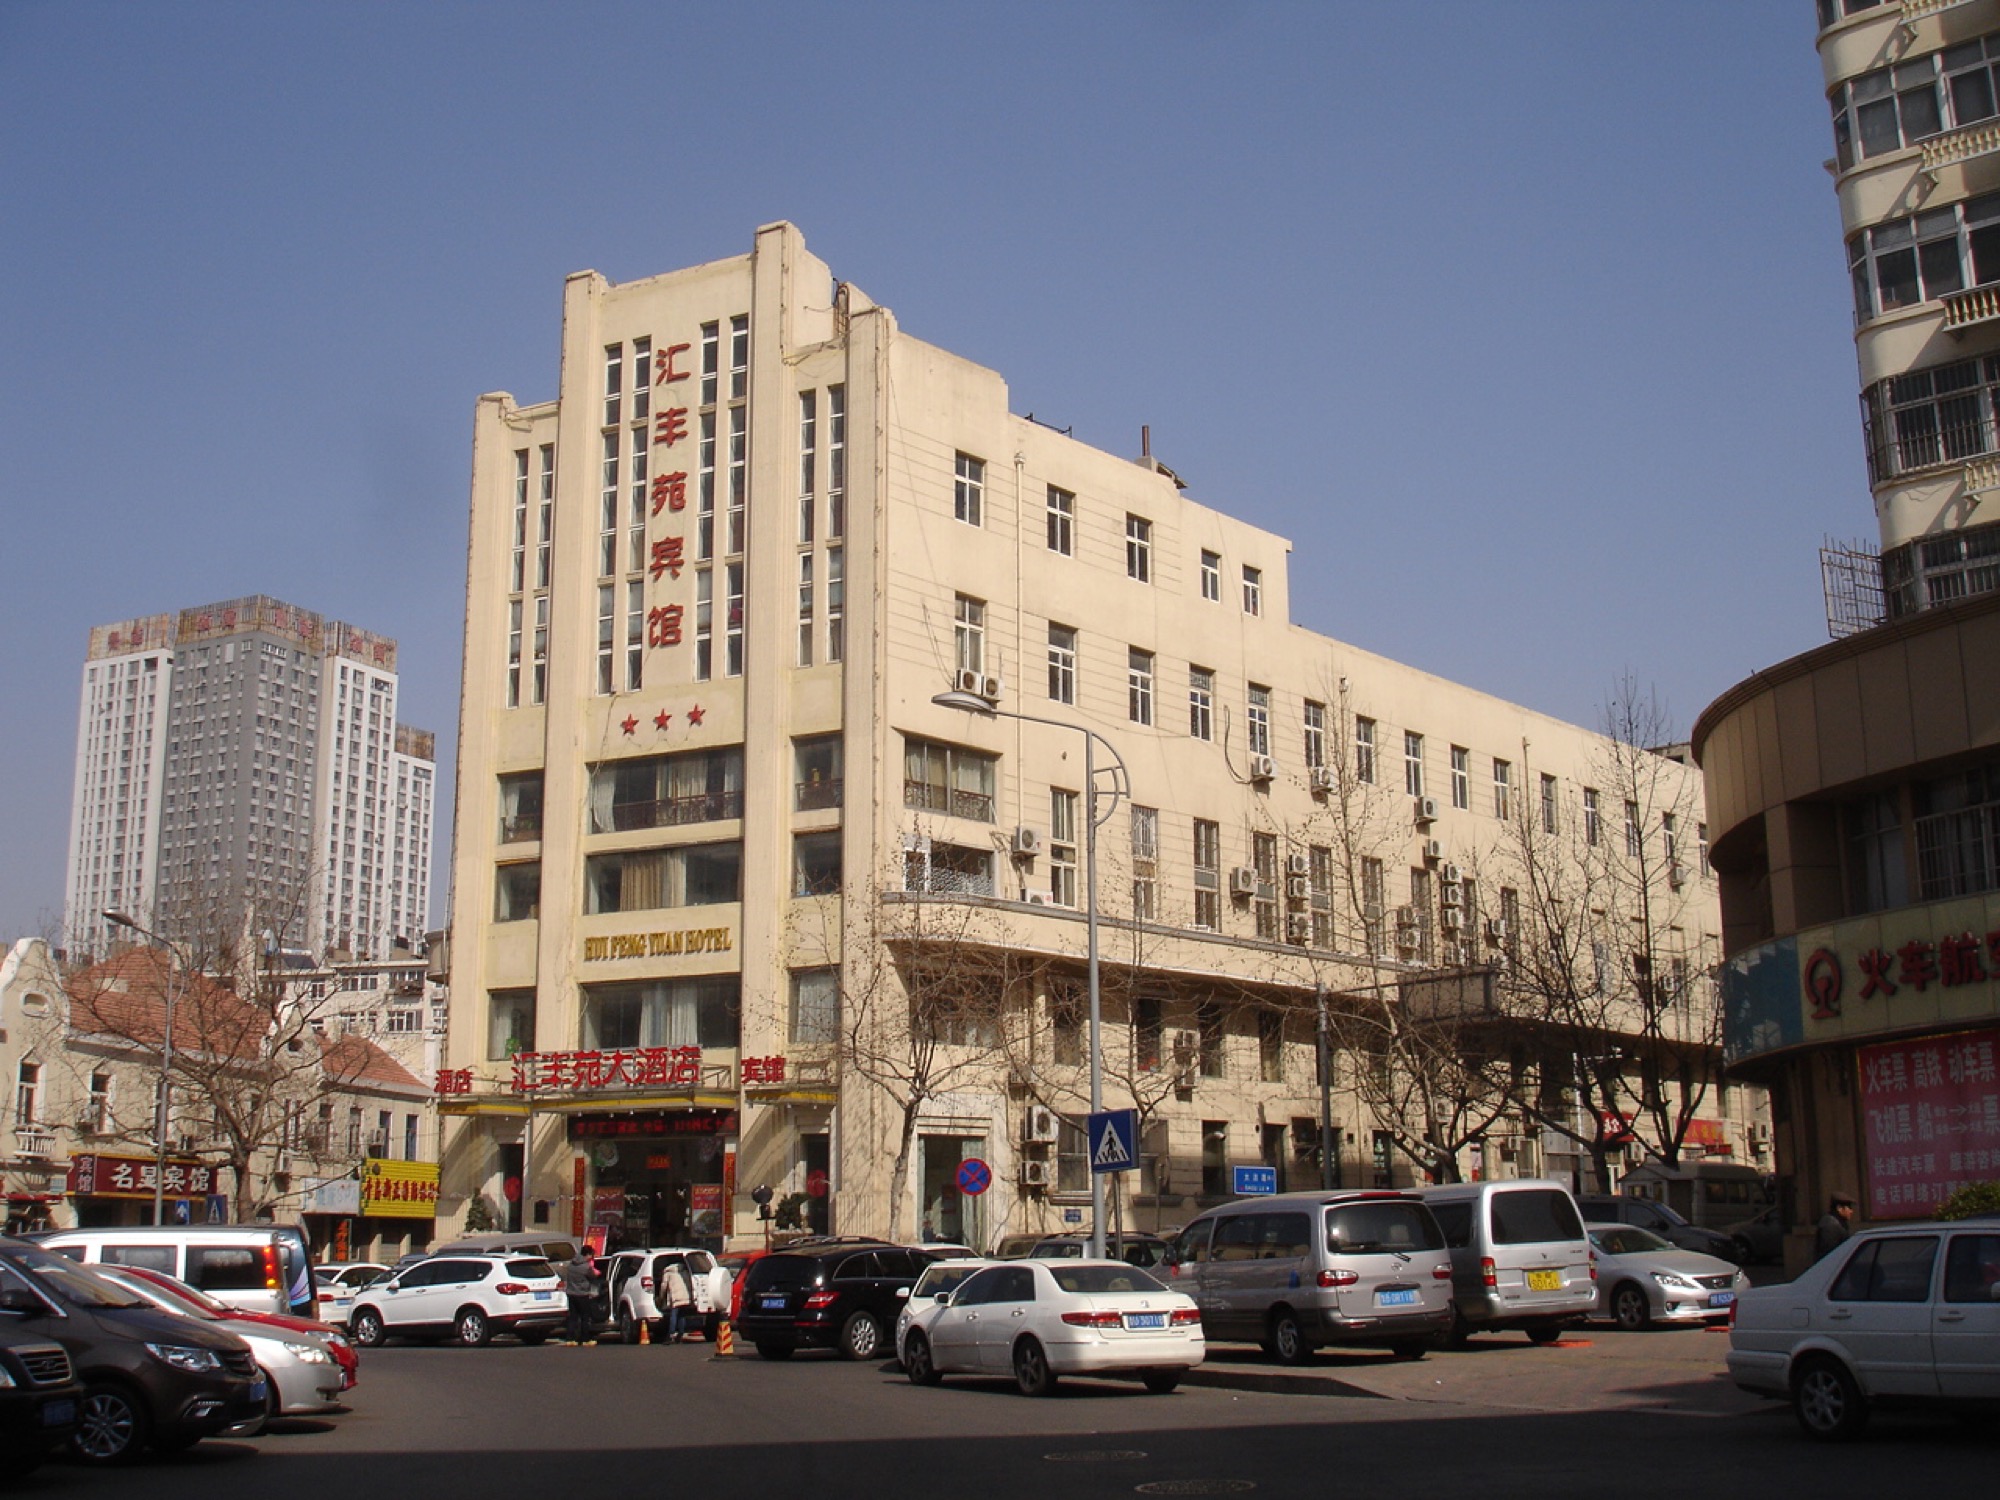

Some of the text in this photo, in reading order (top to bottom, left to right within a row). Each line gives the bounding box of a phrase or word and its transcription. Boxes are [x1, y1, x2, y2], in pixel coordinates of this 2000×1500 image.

[647, 342, 691, 648] 汇丰苑宾馆
[685, 927, 732, 955] HOTEL
[1859, 930, 2000, 999] 火车航
[433, 1068, 473, 1094] 酒店
[511, 1045, 703, 1091] 汇丰苑大酒店
[740, 1055, 786, 1084] 宾馆
[1867, 1041, 1996, 1094] 火车票 高铁 动车票
[1869, 1103, 1913, 1144] 飞机票
